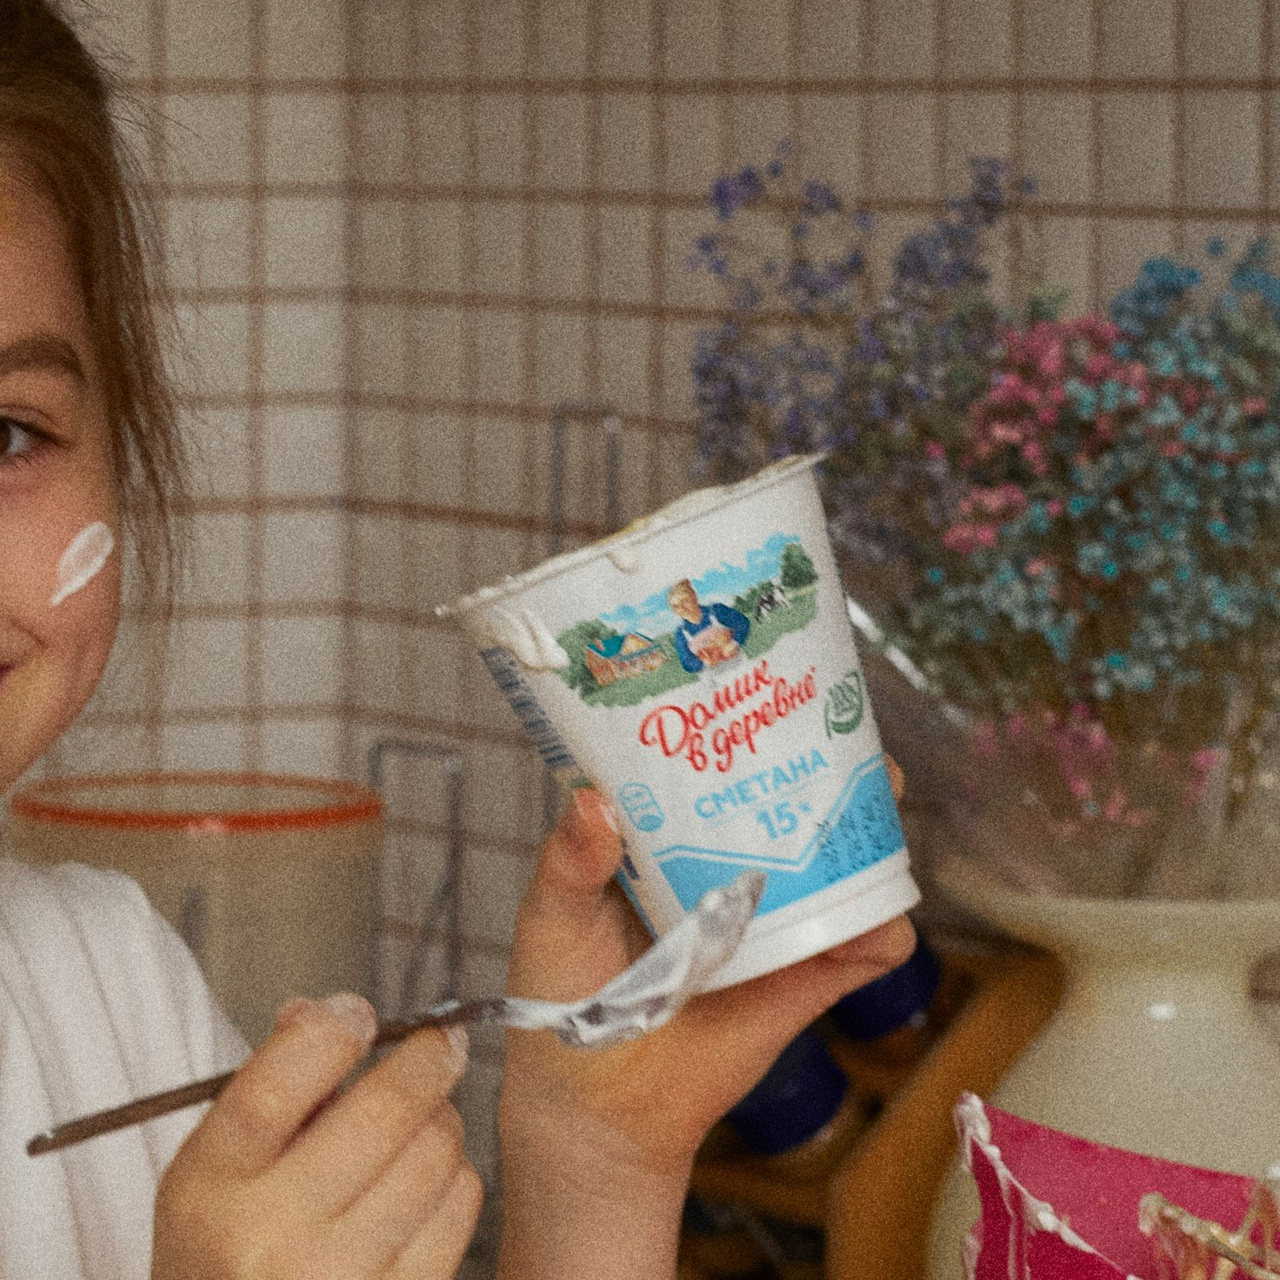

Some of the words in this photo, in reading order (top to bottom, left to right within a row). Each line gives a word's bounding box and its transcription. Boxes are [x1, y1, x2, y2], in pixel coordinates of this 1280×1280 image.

[639, 659, 772, 758] Домик
[686, 732, 708, 772] в
[712, 673, 817, 773] деревне
[694, 748, 829, 819] СМЕТАНА
